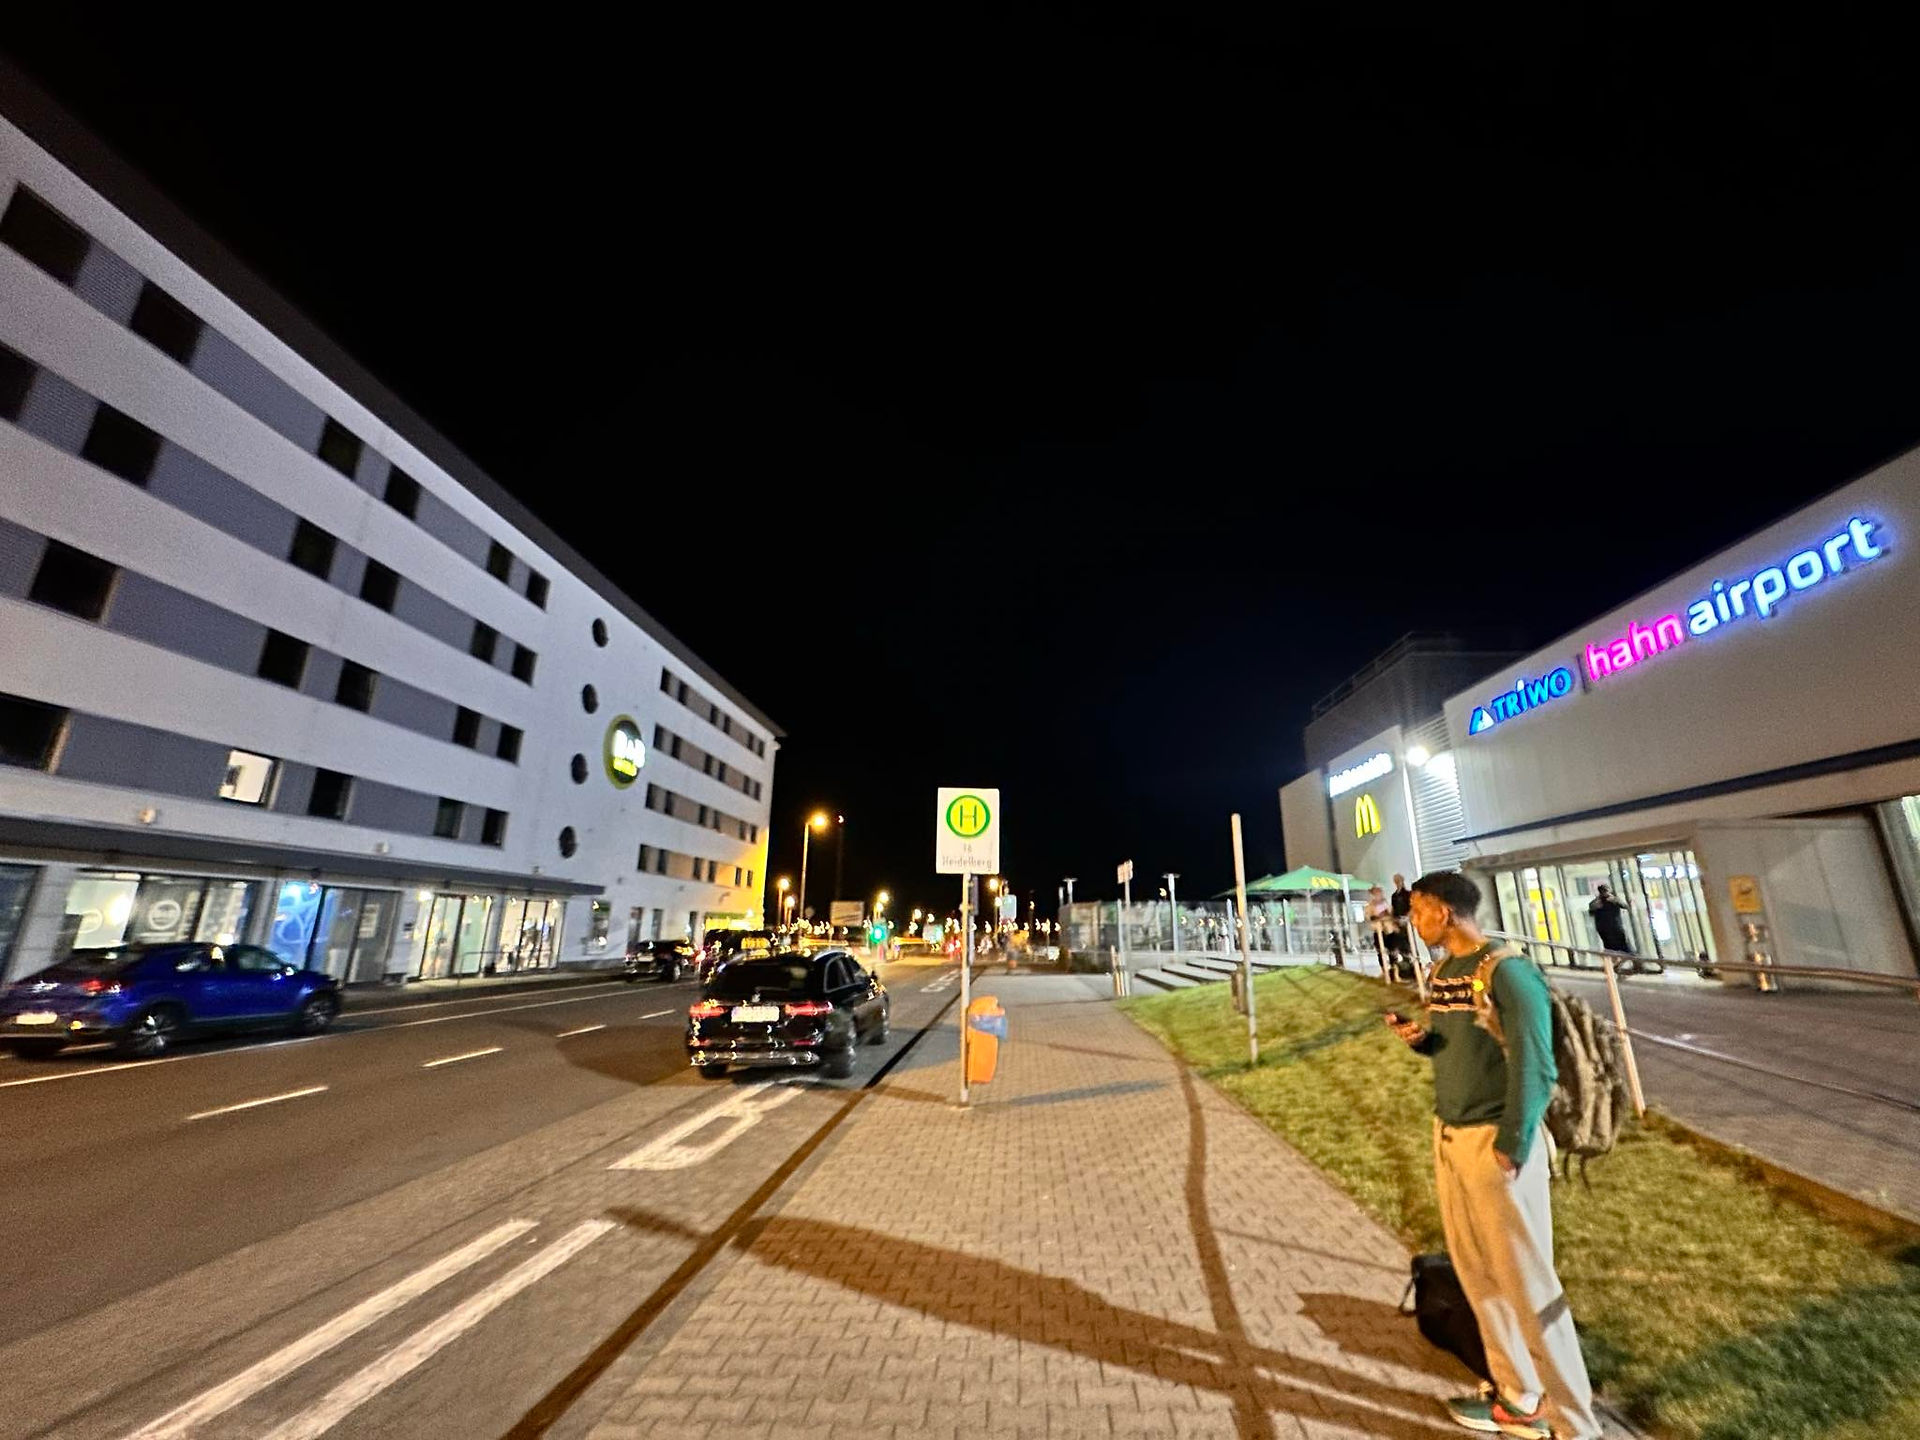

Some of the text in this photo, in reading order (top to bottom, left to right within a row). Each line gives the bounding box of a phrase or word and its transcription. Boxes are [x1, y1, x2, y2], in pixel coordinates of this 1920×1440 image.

[1586, 615, 1684, 682] hahn
[1688, 517, 1882, 637] airport
[960, 804, 978, 829] H
[942, 856, 992, 872] Heidelberg
